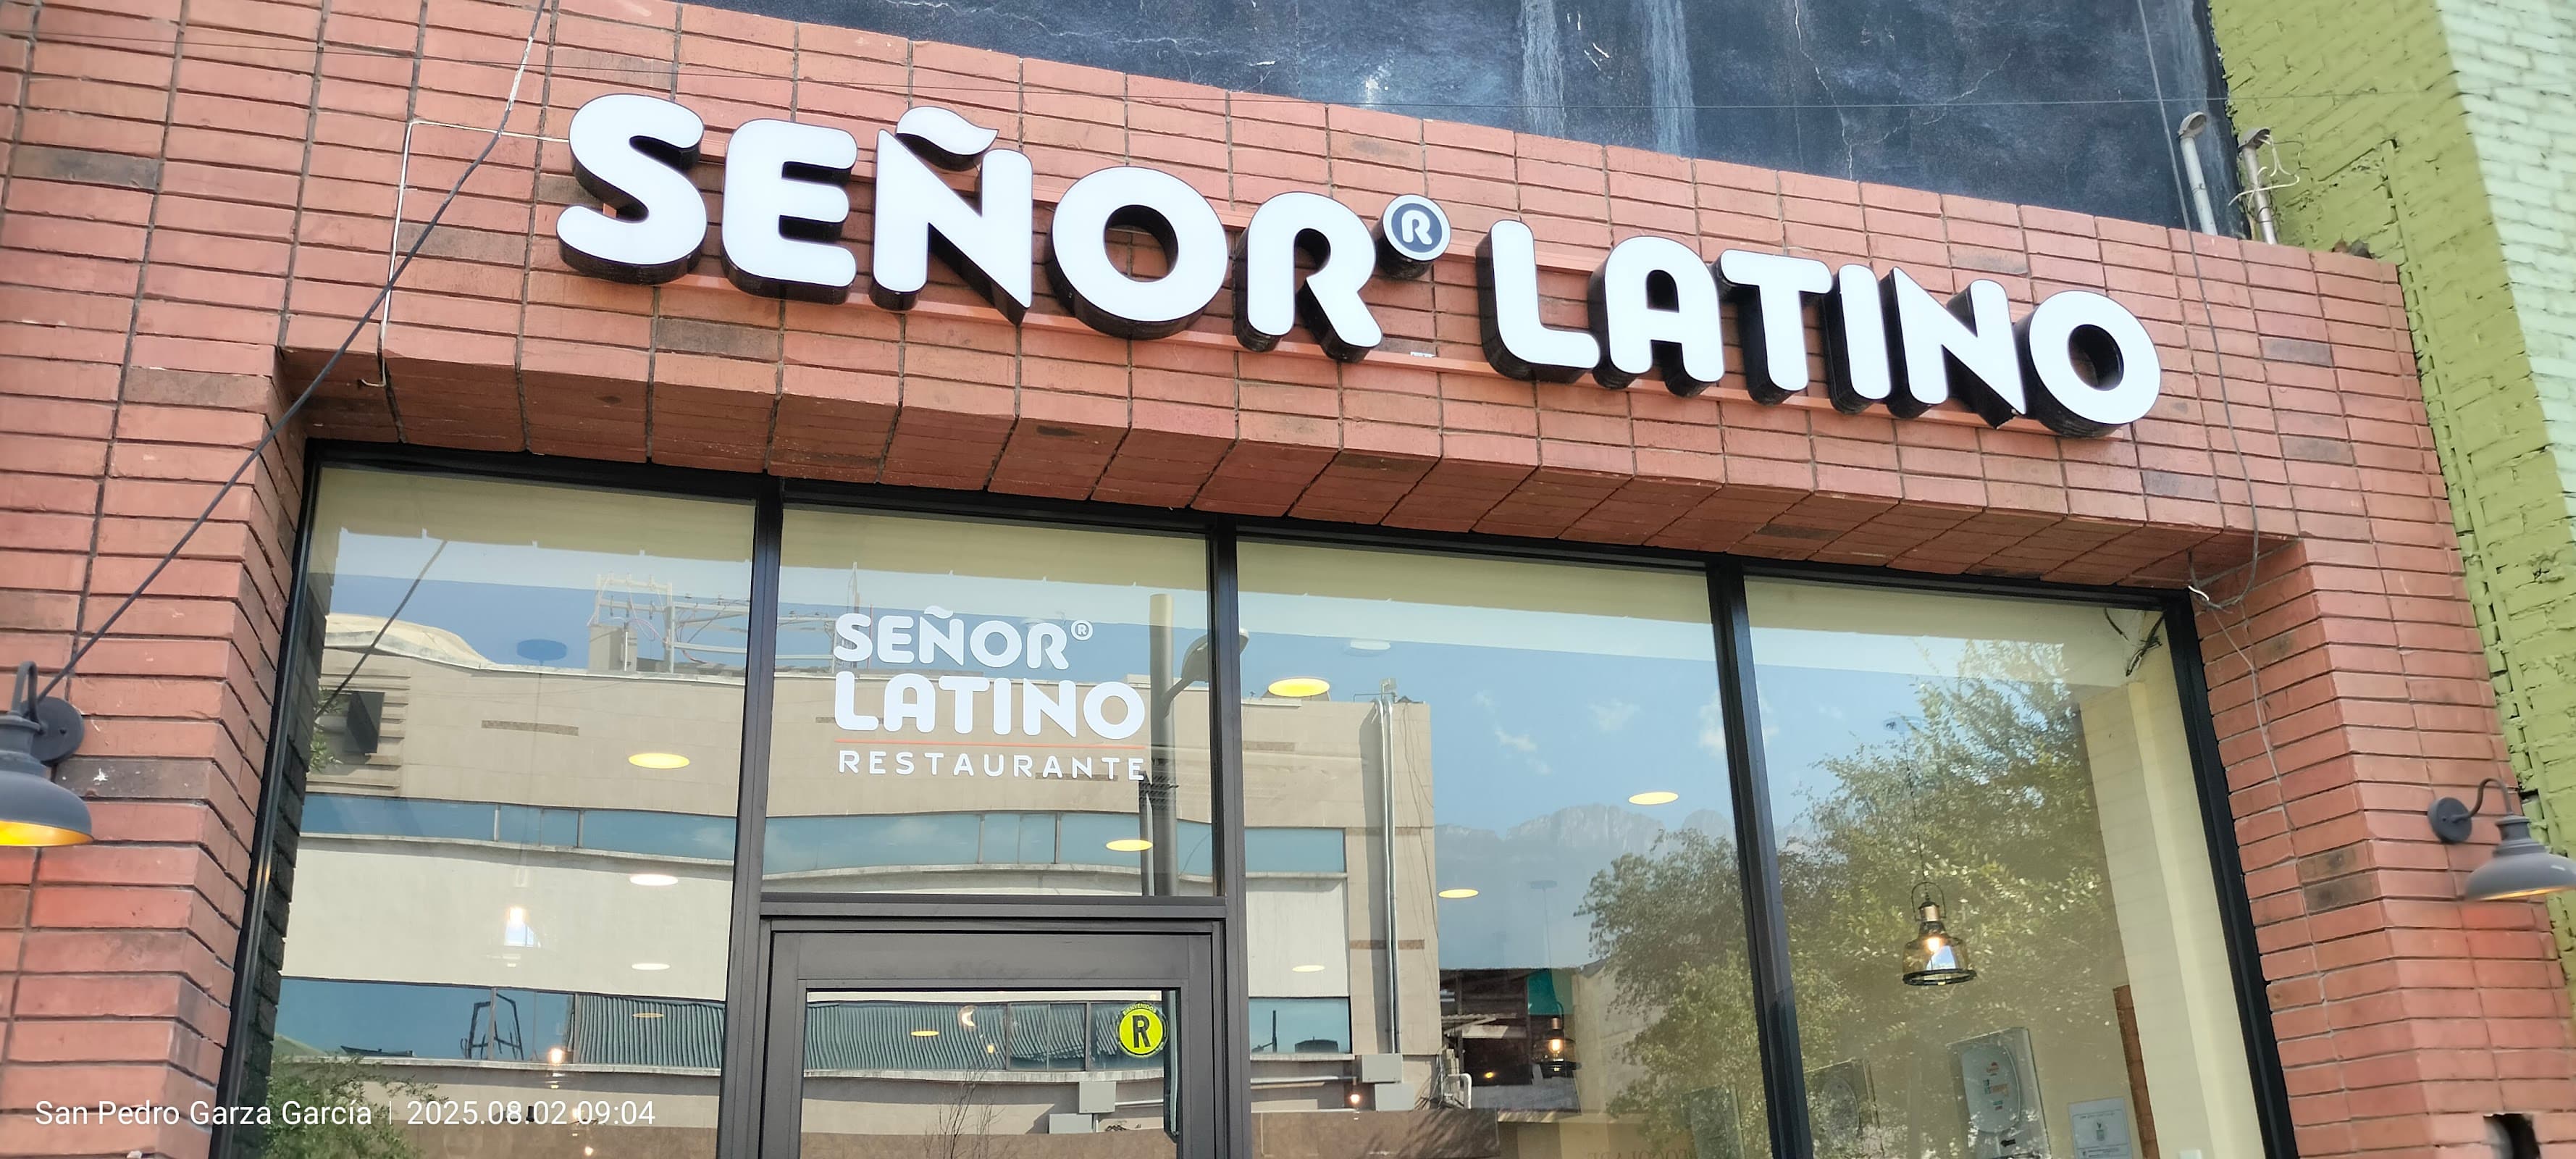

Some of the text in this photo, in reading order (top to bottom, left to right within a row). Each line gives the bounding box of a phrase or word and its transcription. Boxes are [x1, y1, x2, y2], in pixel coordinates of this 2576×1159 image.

[1490, 219, 2162, 424] LATINO
[834, 671, 1146, 740] LATINO
[838, 749, 1145, 782] RESTAURANTE
[1133, 1015, 1151, 1047] R
